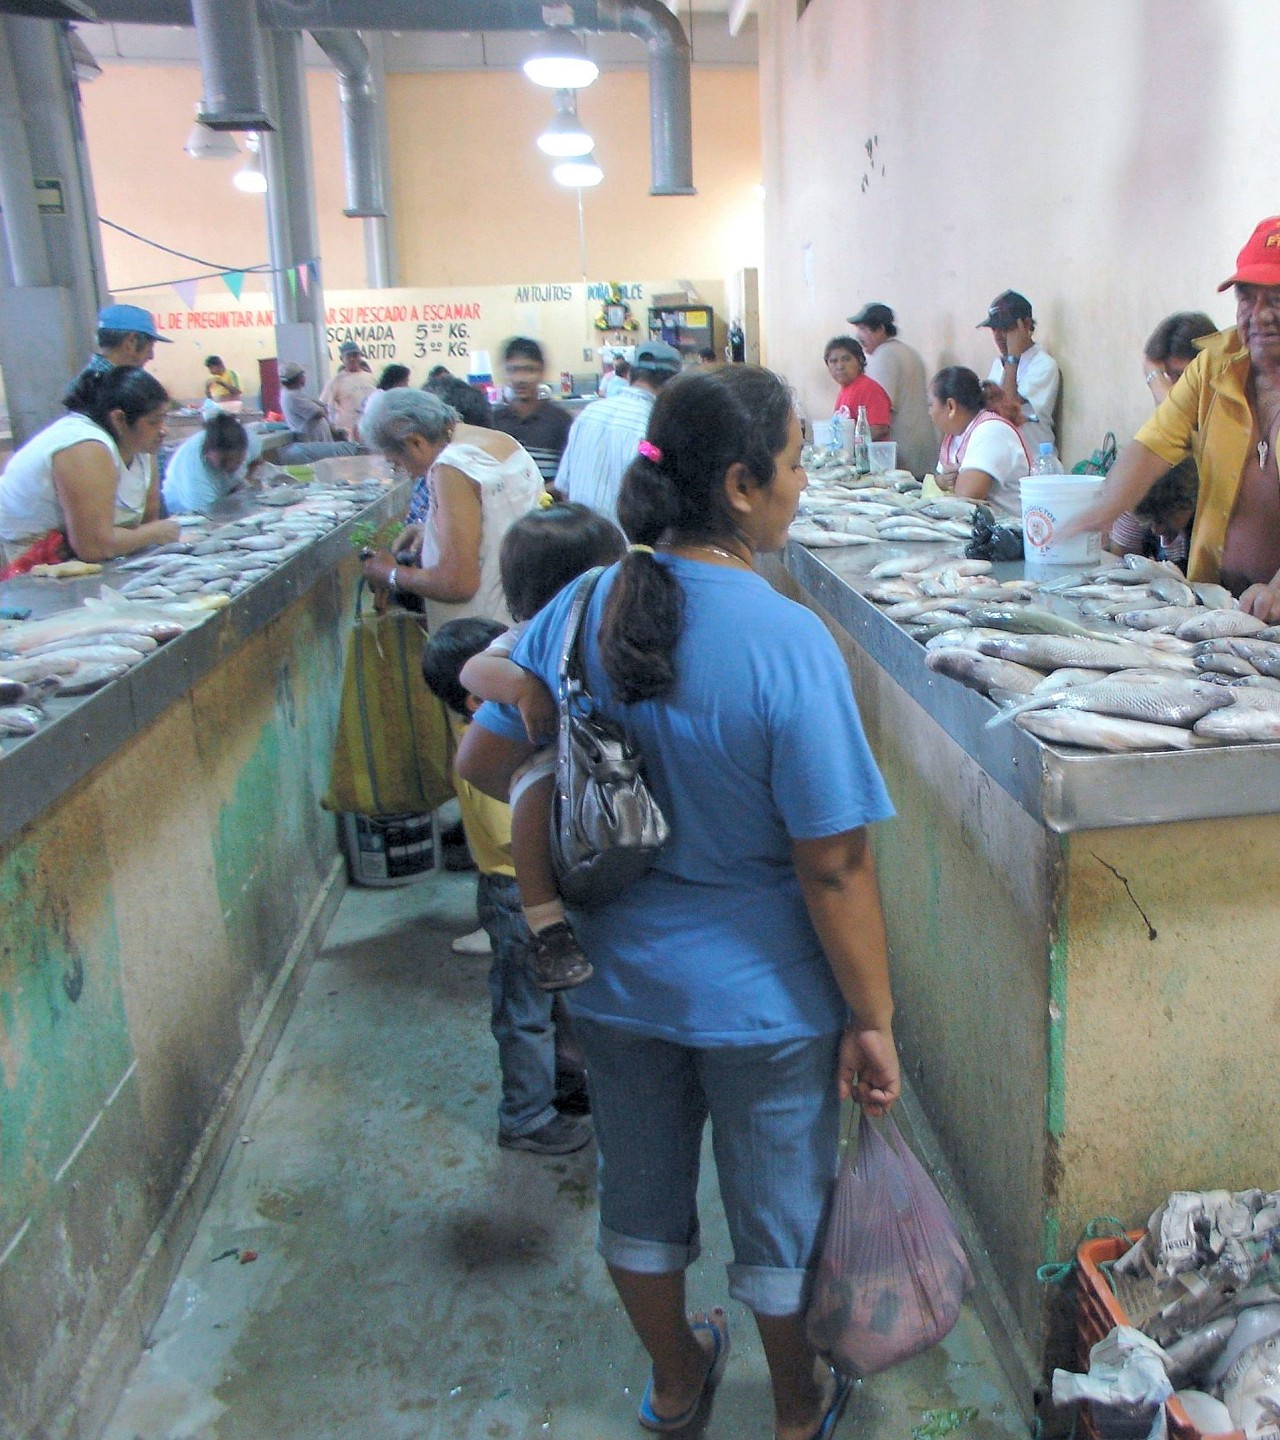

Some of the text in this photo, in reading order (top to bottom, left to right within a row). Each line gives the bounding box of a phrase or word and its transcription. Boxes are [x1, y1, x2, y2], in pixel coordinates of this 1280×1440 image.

[515, 284, 572, 303] ANTOJITOS
[168, 313, 183, 330] DE
[187, 310, 254, 330] PREGUNTAR
[256, 310, 276, 328] AN
[339, 307, 353, 324] SU
[356, 305, 407, 324] PESCADO
[410, 304, 419, 321] A
[423, 302, 481, 321] ESCAMAR
